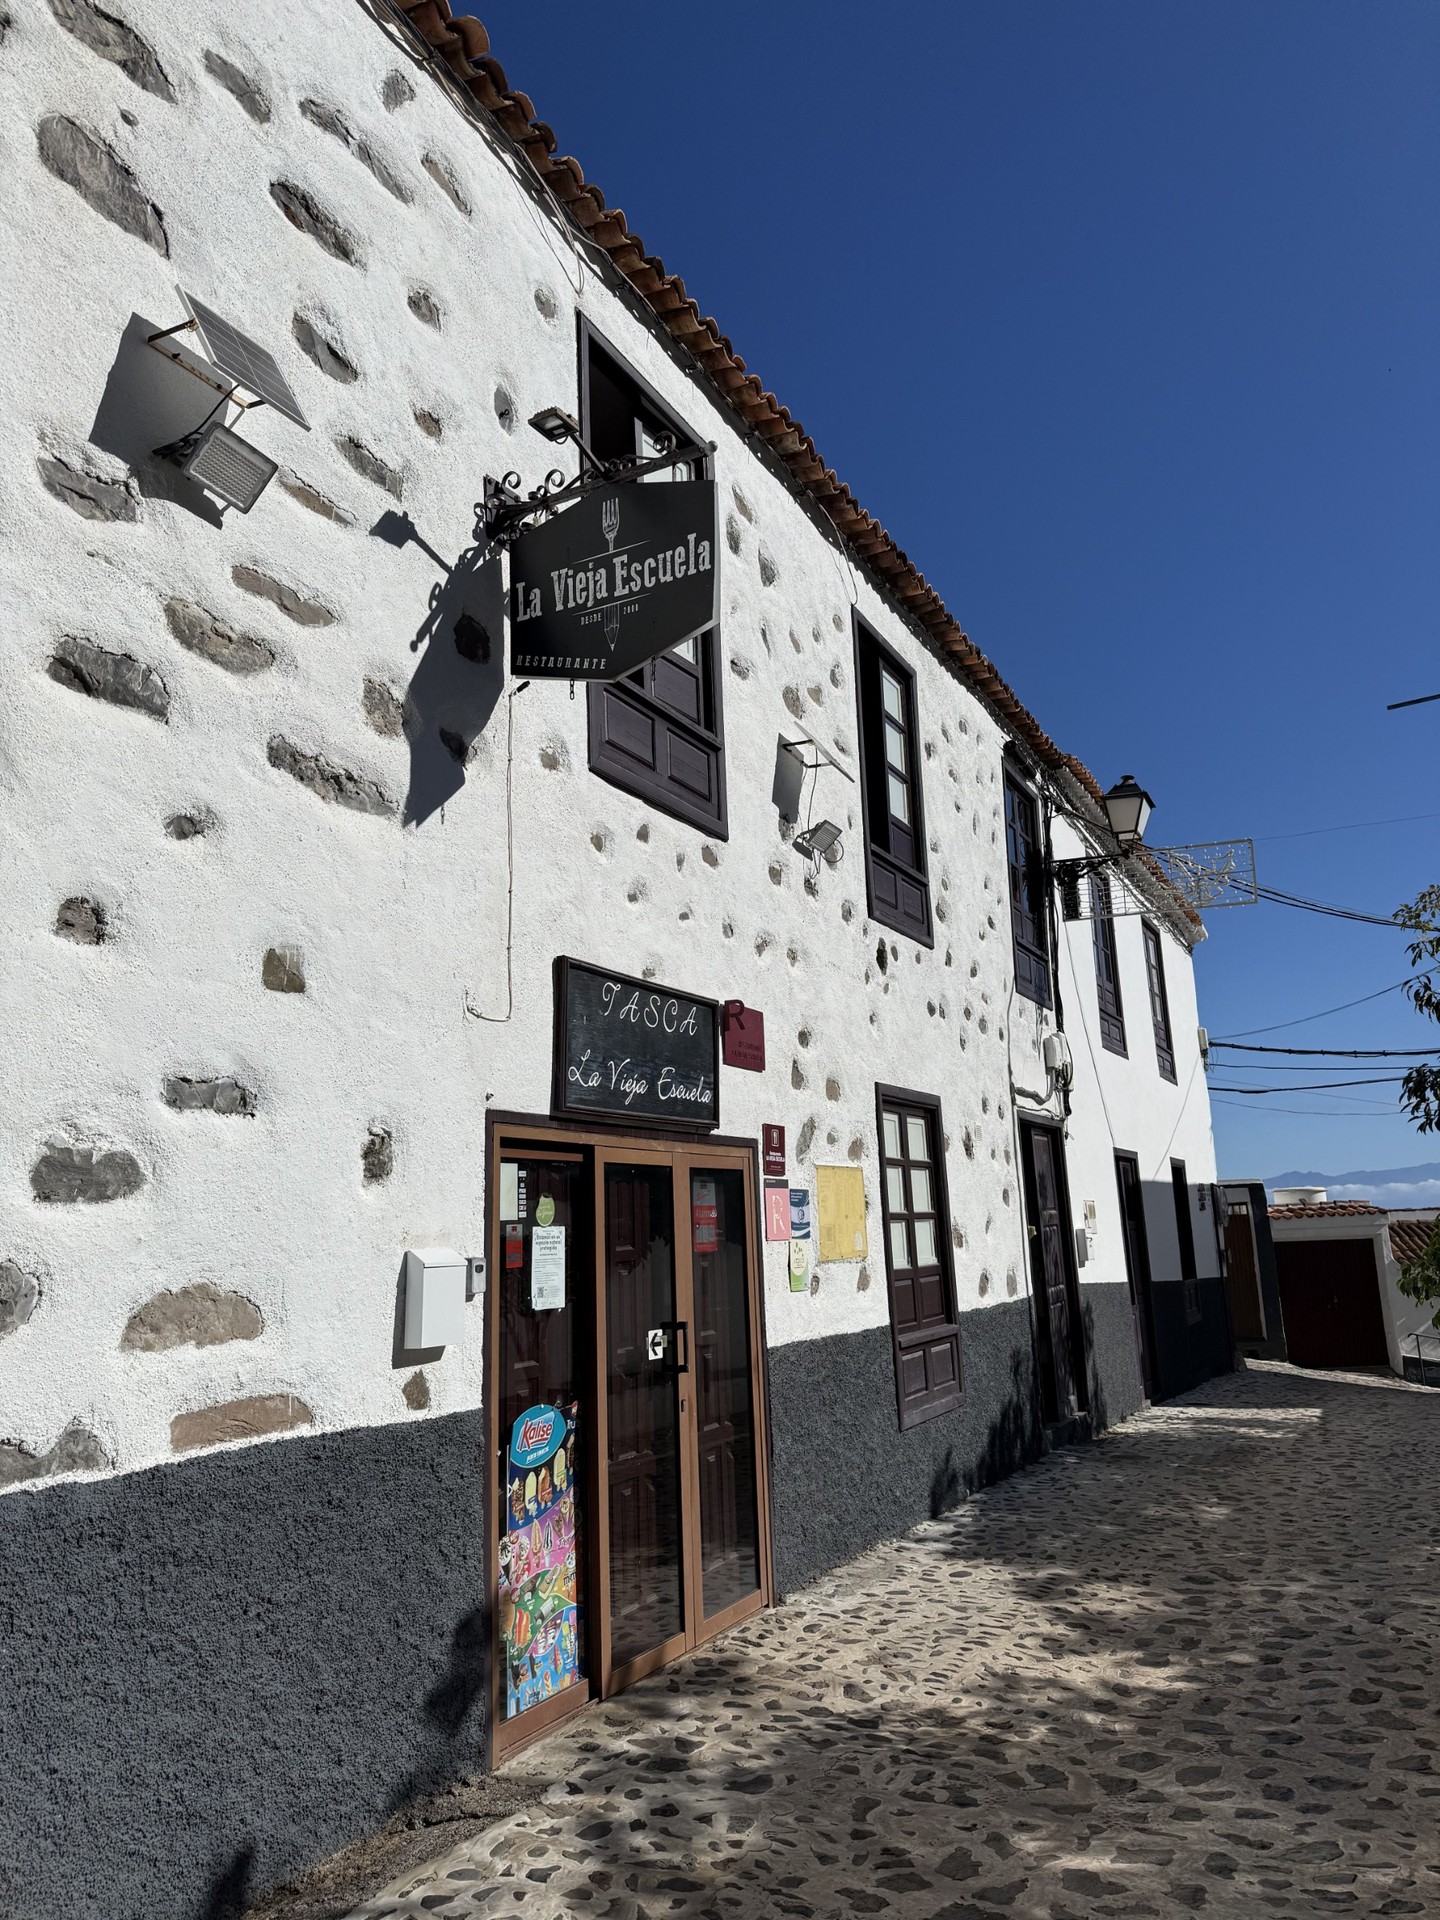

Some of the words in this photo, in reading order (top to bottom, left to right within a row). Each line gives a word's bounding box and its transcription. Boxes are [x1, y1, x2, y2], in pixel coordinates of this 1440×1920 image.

[516, 582, 542, 622] La
[551, 562, 608, 612] Vieja
[613, 533, 712, 597] Escuela
[580, 612, 602, 625] DESDE
[516, 655, 607, 670] RESTAURANTE
[602, 982, 697, 1036] TASCA
[568, 1049, 602, 1087] La
[608, 1058, 649, 1106] Vieja
[657, 1066, 712, 1103] Escuela
[519, 1418, 553, 1452] Kalise
